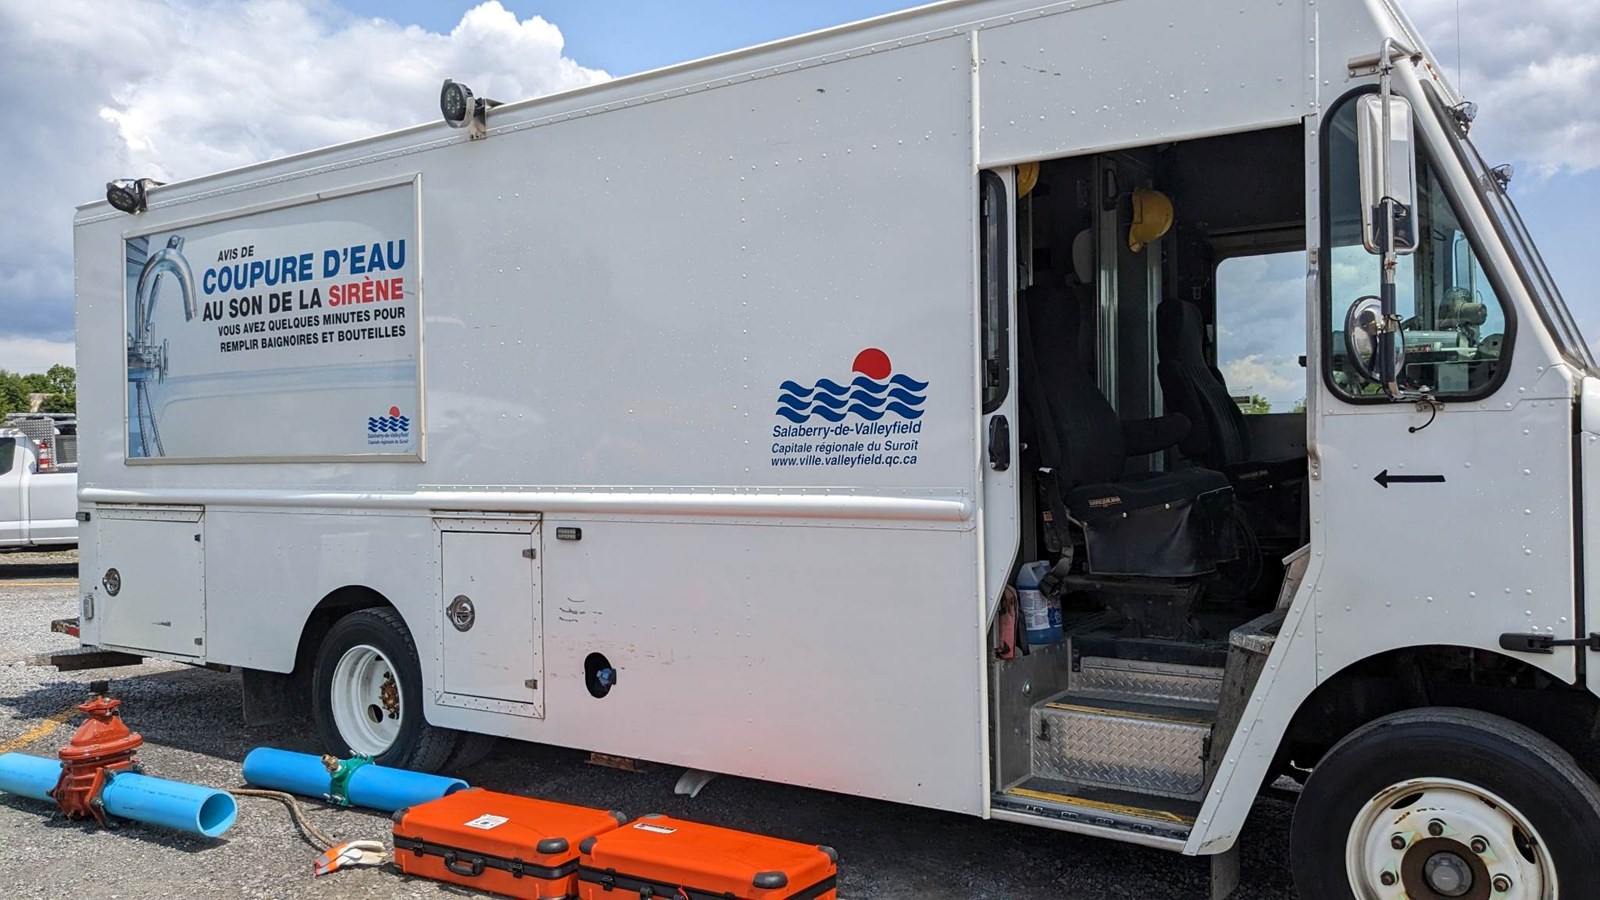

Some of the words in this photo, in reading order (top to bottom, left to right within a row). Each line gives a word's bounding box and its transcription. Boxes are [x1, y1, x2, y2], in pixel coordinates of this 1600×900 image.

[218, 248, 238, 262] AVIS
[241, 245, 254, 257] DE
[203, 253, 314, 295] COUPURE
[323, 239, 406, 278] D'EAU
[203, 300, 223, 321] AU
[229, 295, 262, 319] SON
[269, 291, 292, 313] DE
[300, 288, 322, 310] LA
[328, 276, 404, 307] SIRÈNE
[218, 323, 240, 336] VOUS
[243, 321, 265, 334] AVEZ
[269, 315, 320, 331] QUELQUES
[323, 310, 370, 325] MINUTES
[374, 307, 405, 320] POUR
[220, 338, 259, 353] REMPLIR
[262, 333, 319, 348] BAIGNOIRES
[322, 332, 334, 342] ET
[338, 325, 406, 342] BOUTEILLES
[773, 421, 921, 439] Salaberry-de-Valleyfield
[771, 443, 812, 455] Capitale
[815, 442, 864, 454] régionale
[867, 441, 881, 451] du
[884, 440, 918, 451] Suroît
[771, 454, 917, 468] www.ville.valleyfield.qc.ca
